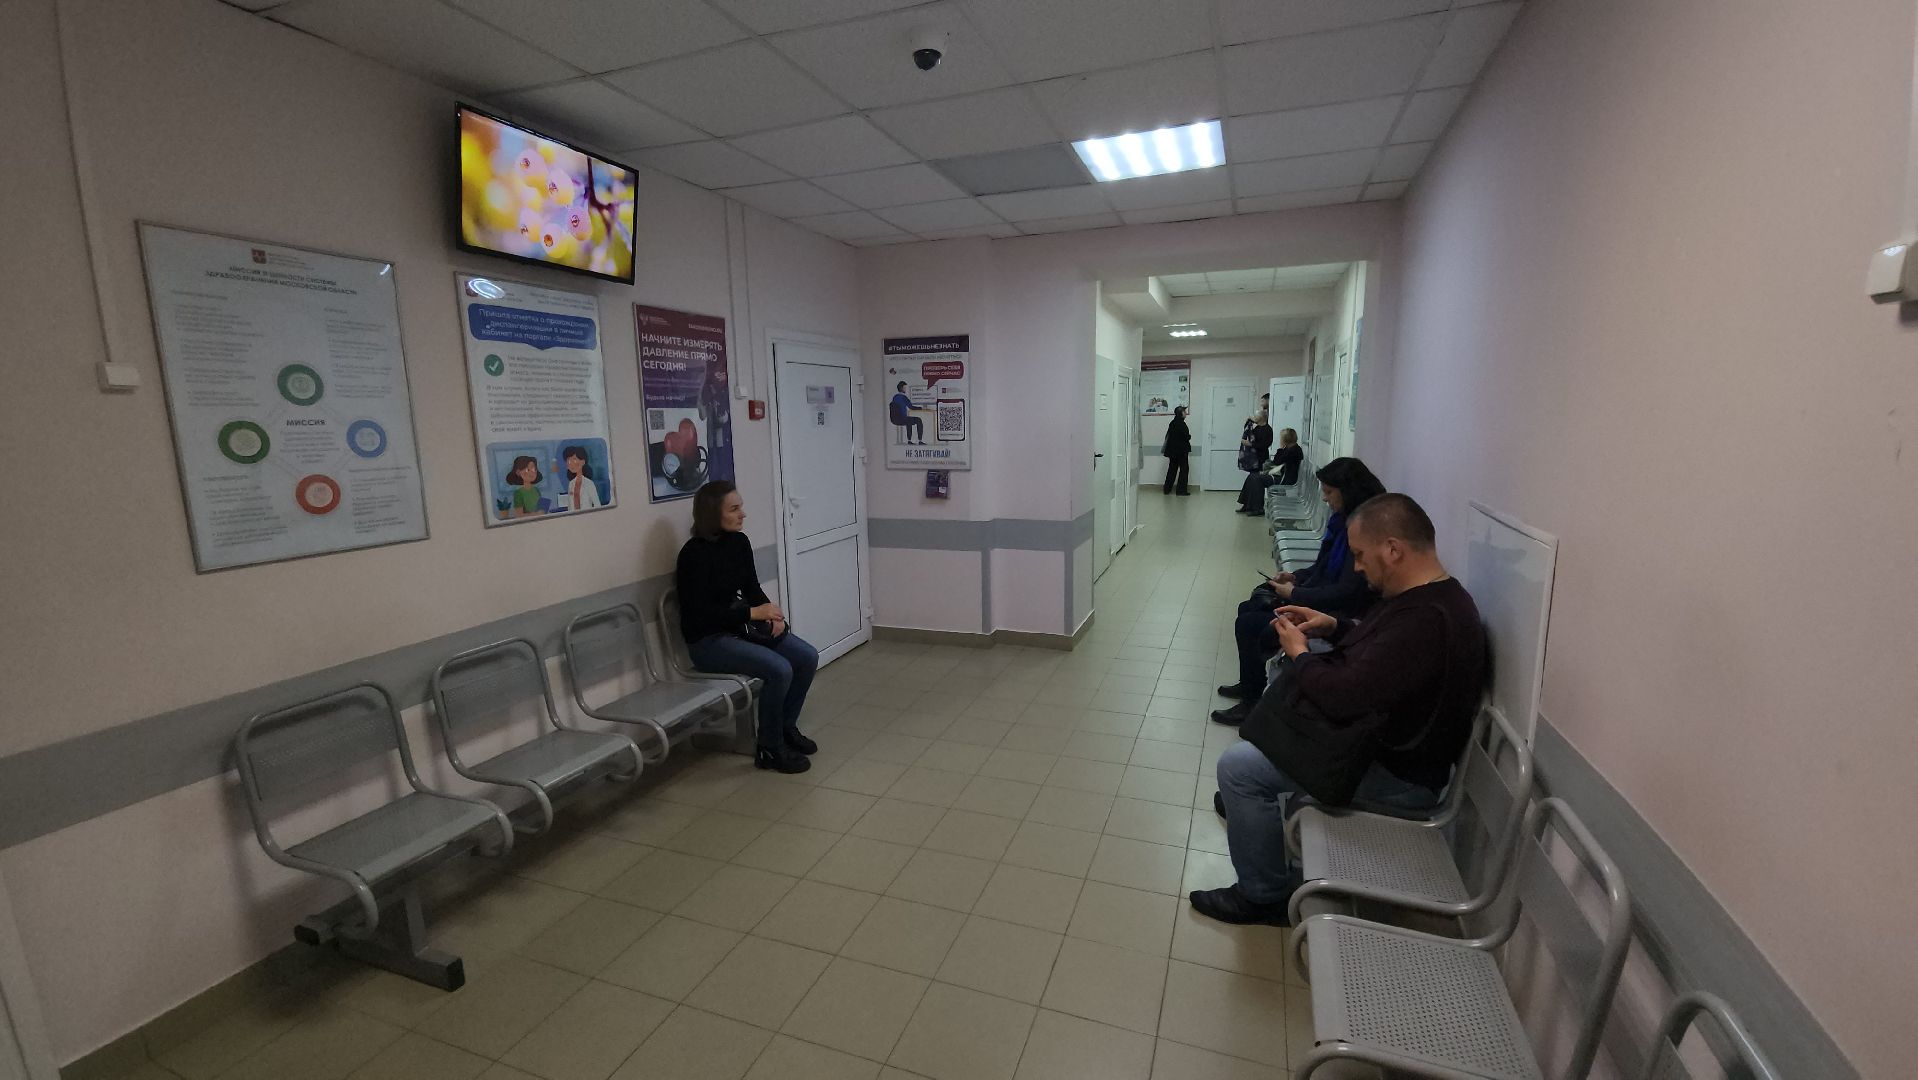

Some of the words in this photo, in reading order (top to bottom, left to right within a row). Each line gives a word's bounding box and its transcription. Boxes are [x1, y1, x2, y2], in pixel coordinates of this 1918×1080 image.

[641, 333, 682, 346] НАЧНИТЕ
[683, 339, 723, 351] ИЗМЕРЯТЬ
[642, 346, 690, 360] ДАВЛЕНИЕ
[690, 351, 718, 362] ПРЯМО
[643, 360, 687, 372] СЕГОДНЯ!
[286, 418, 328, 426] МИССИЯ
[905, 449, 913, 458] НЕ
[914, 448, 951, 458] ЗАТЯГИВАЙ!
